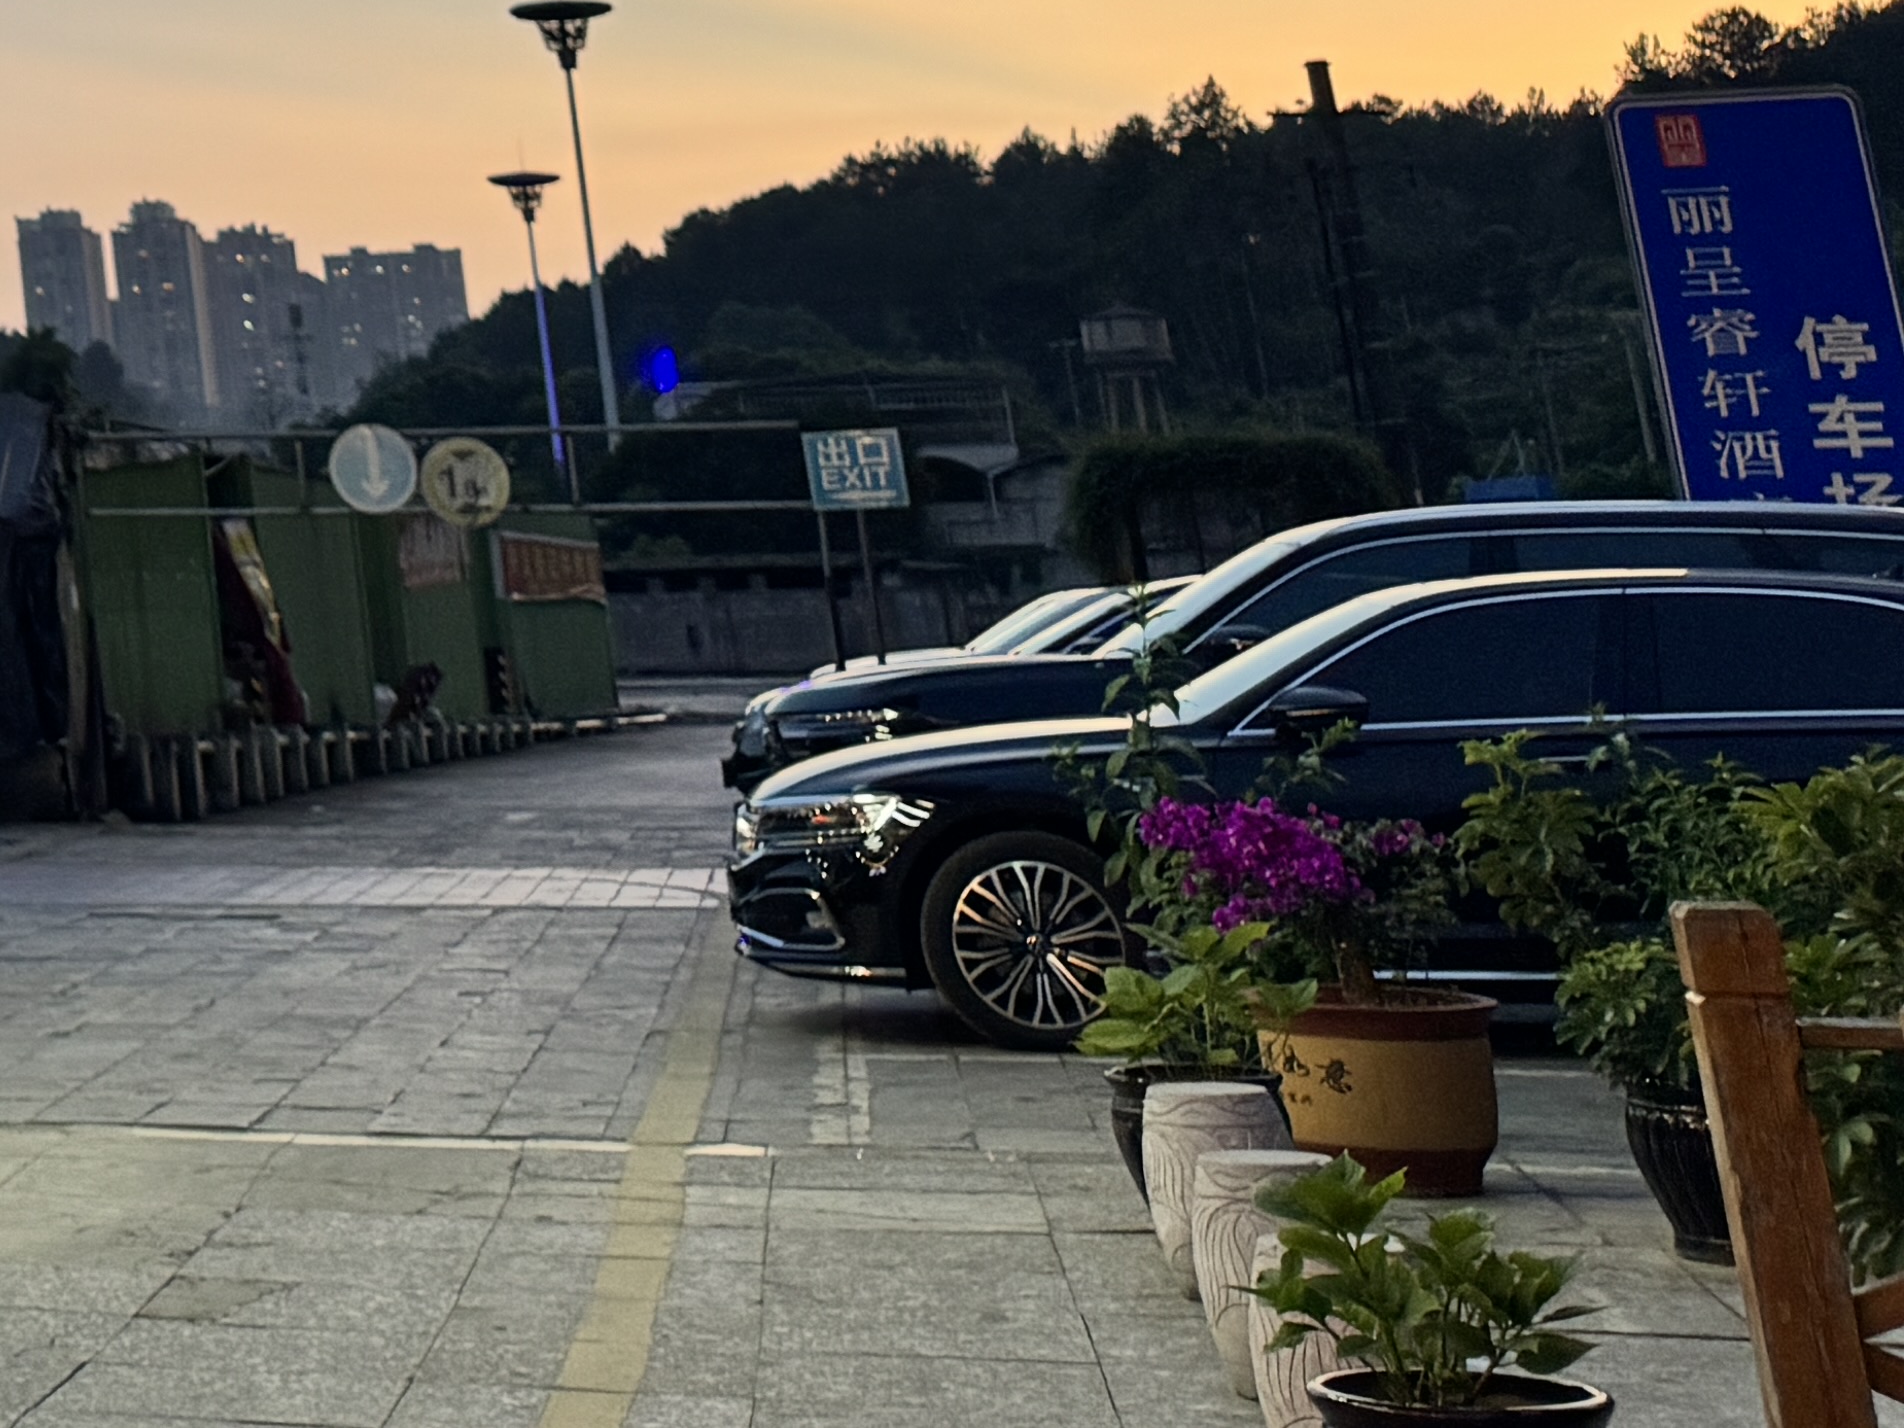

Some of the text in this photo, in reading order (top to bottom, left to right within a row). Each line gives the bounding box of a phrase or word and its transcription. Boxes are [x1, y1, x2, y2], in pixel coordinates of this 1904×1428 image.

[1661, 185, 1790, 501] 丽呈睿轩酒
[817, 436, 890, 467] 出口
[821, 465, 890, 491] EXIT
